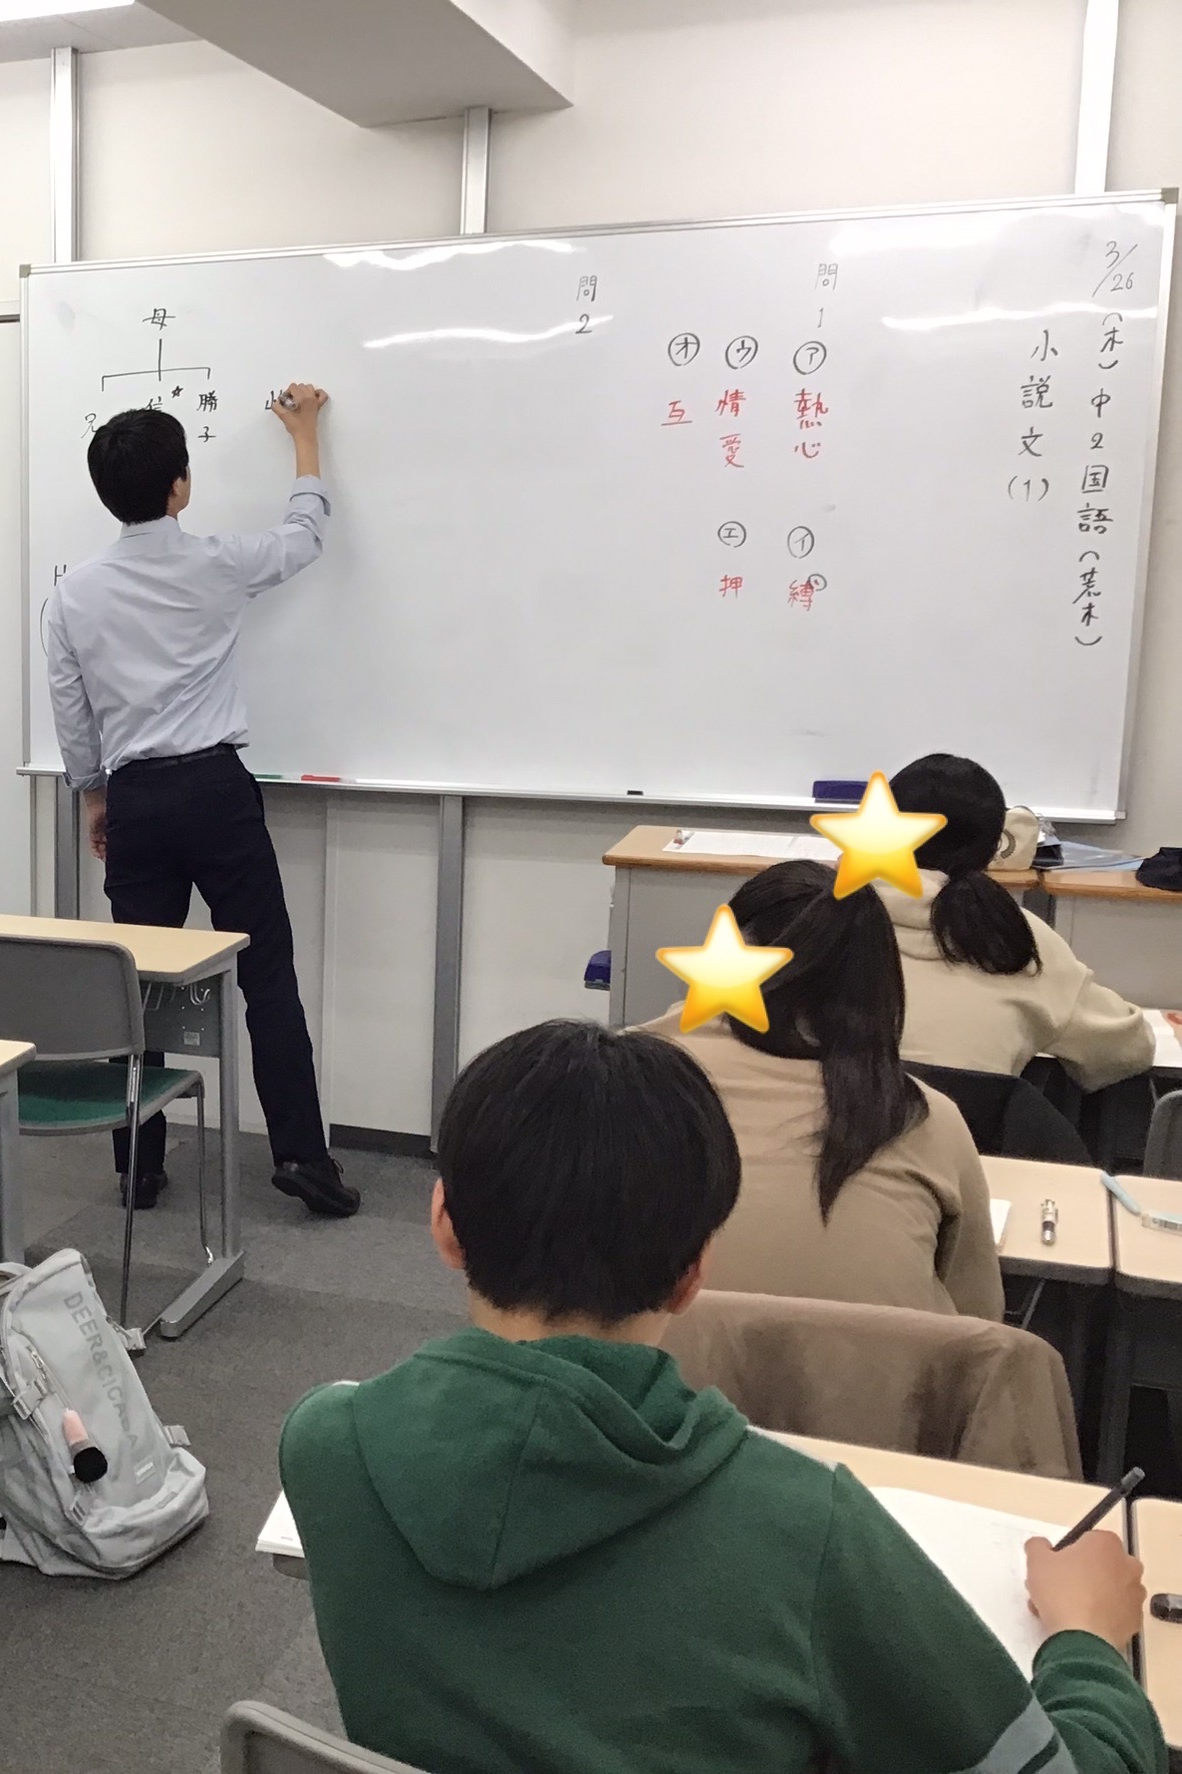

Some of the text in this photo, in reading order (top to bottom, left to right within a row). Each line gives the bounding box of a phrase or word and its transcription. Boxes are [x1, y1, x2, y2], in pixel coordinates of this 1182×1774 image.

[142, 308, 176, 331] 母
[575, 275, 598, 334] 問2
[196, 390, 218, 443] 勝子
[661, 400, 693, 427] 互
[793, 388, 829, 459] 熱心
[719, 574, 744, 599] 押
